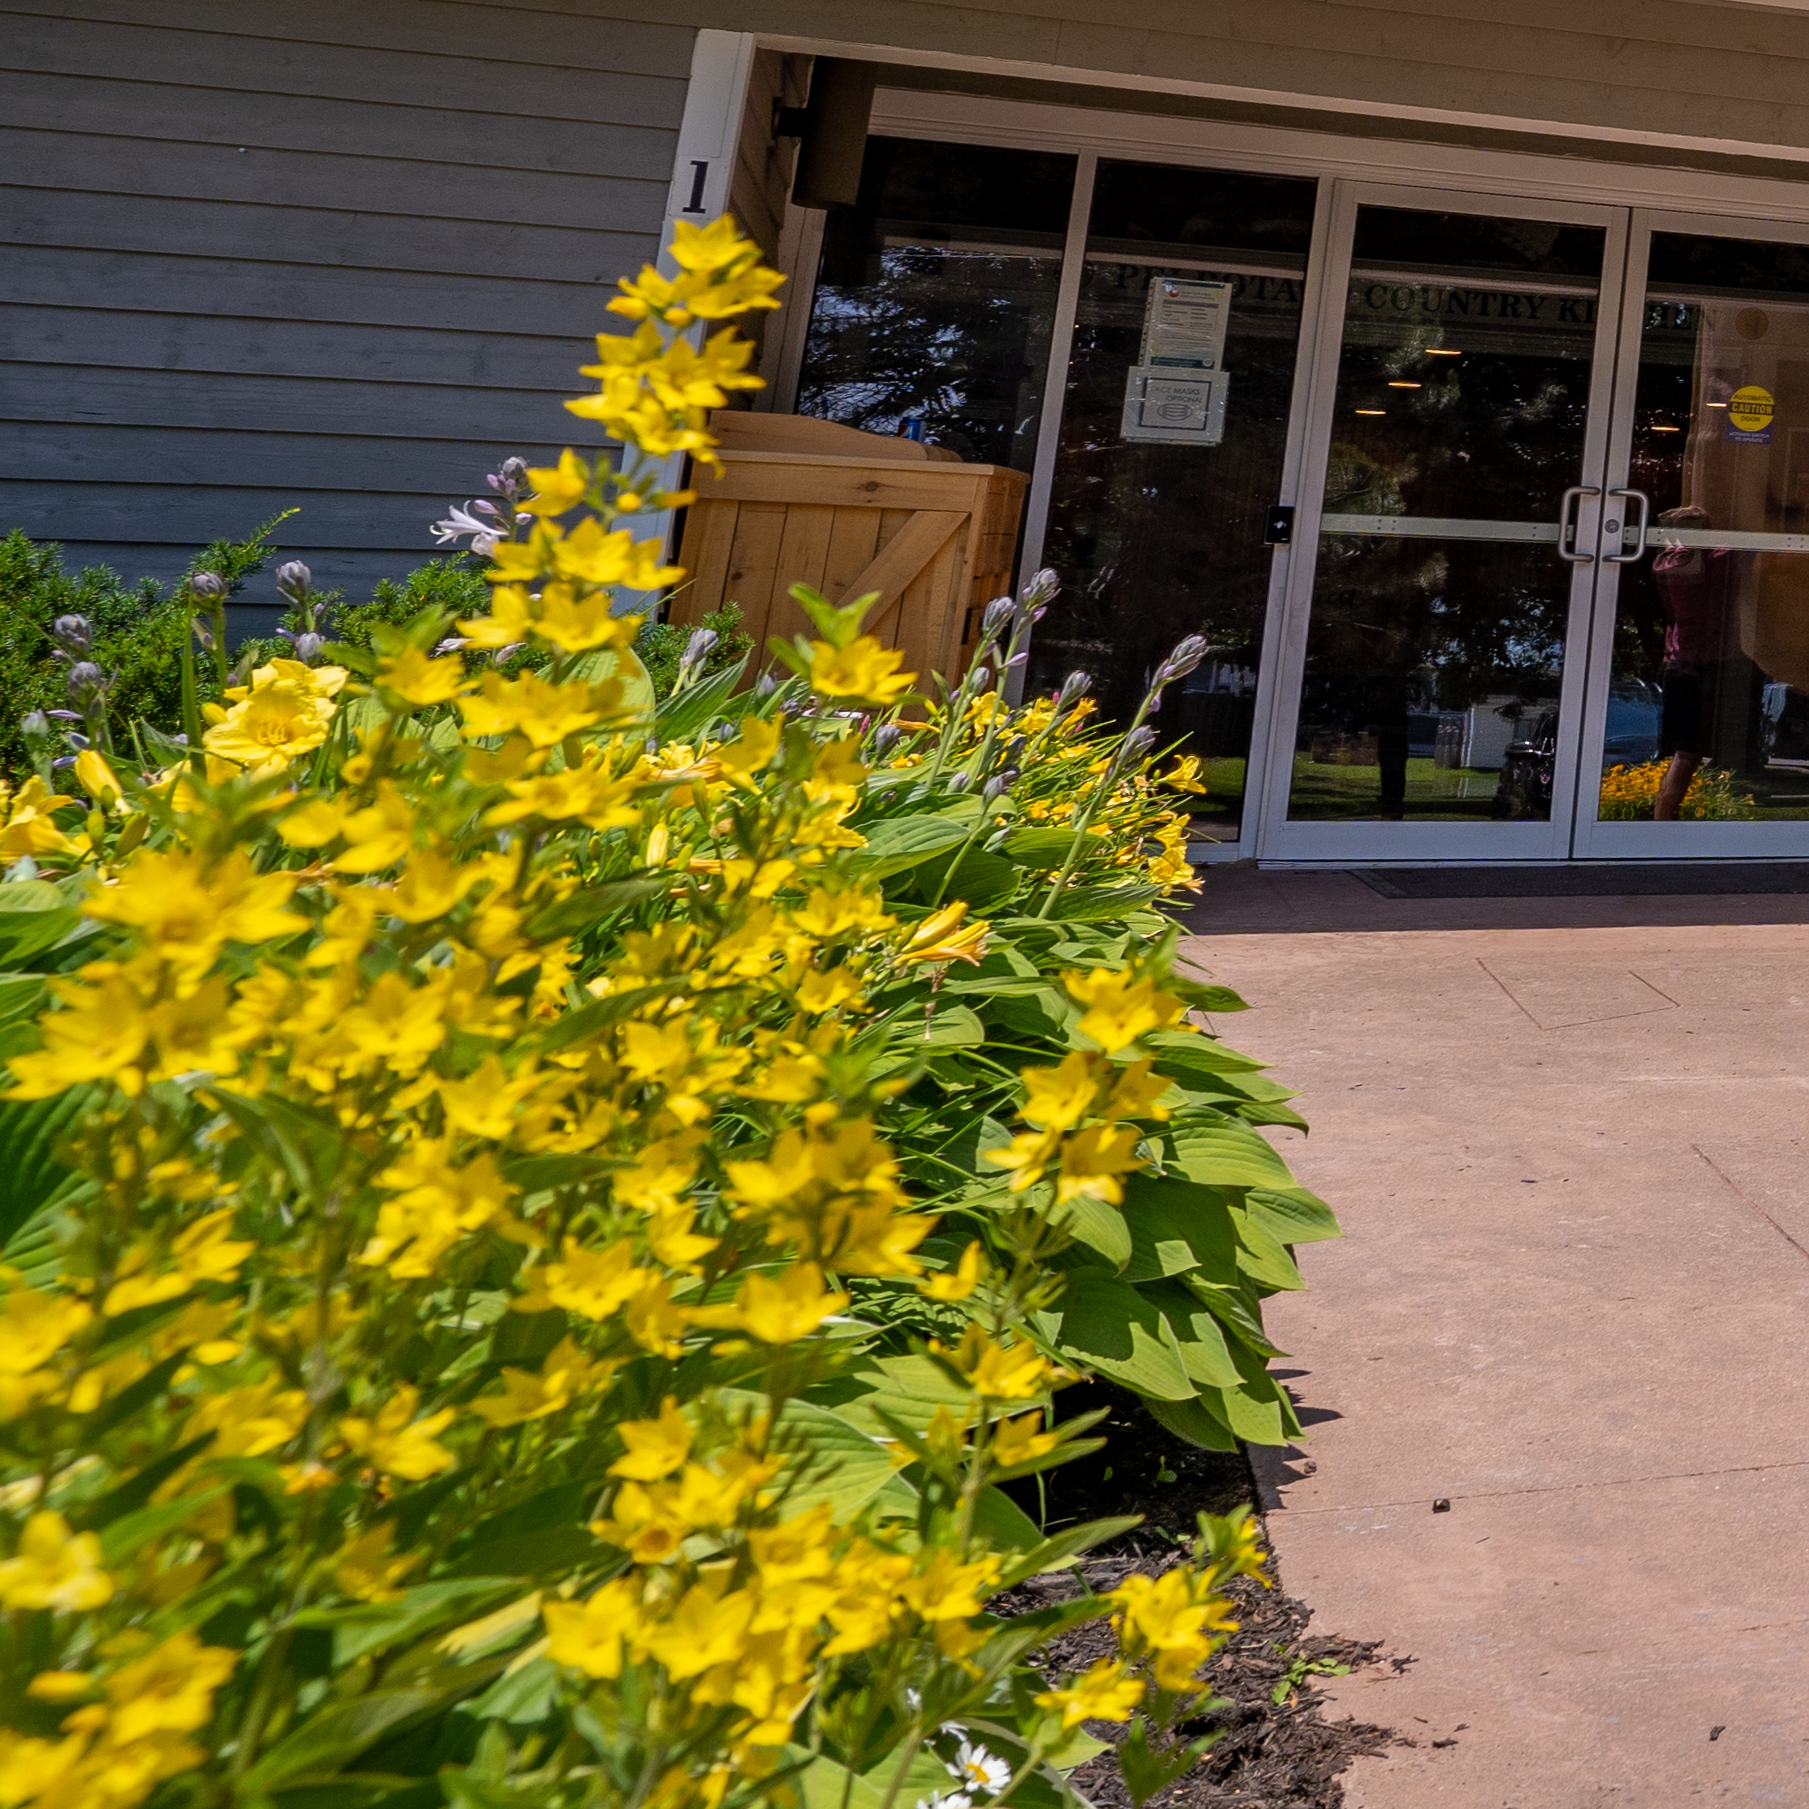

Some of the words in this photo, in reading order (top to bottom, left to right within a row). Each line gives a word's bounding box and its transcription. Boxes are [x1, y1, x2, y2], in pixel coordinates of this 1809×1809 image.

[682, 160, 708, 213] 1
[1365, 282, 1546, 320] COUNTRY
[1173, 387, 1200, 395] MASKS
[1166, 395, 1203, 403] OPTIONAL
[1734, 394, 1772, 402] AUTOMATIC
[1732, 403, 1773, 414] CAUTION
